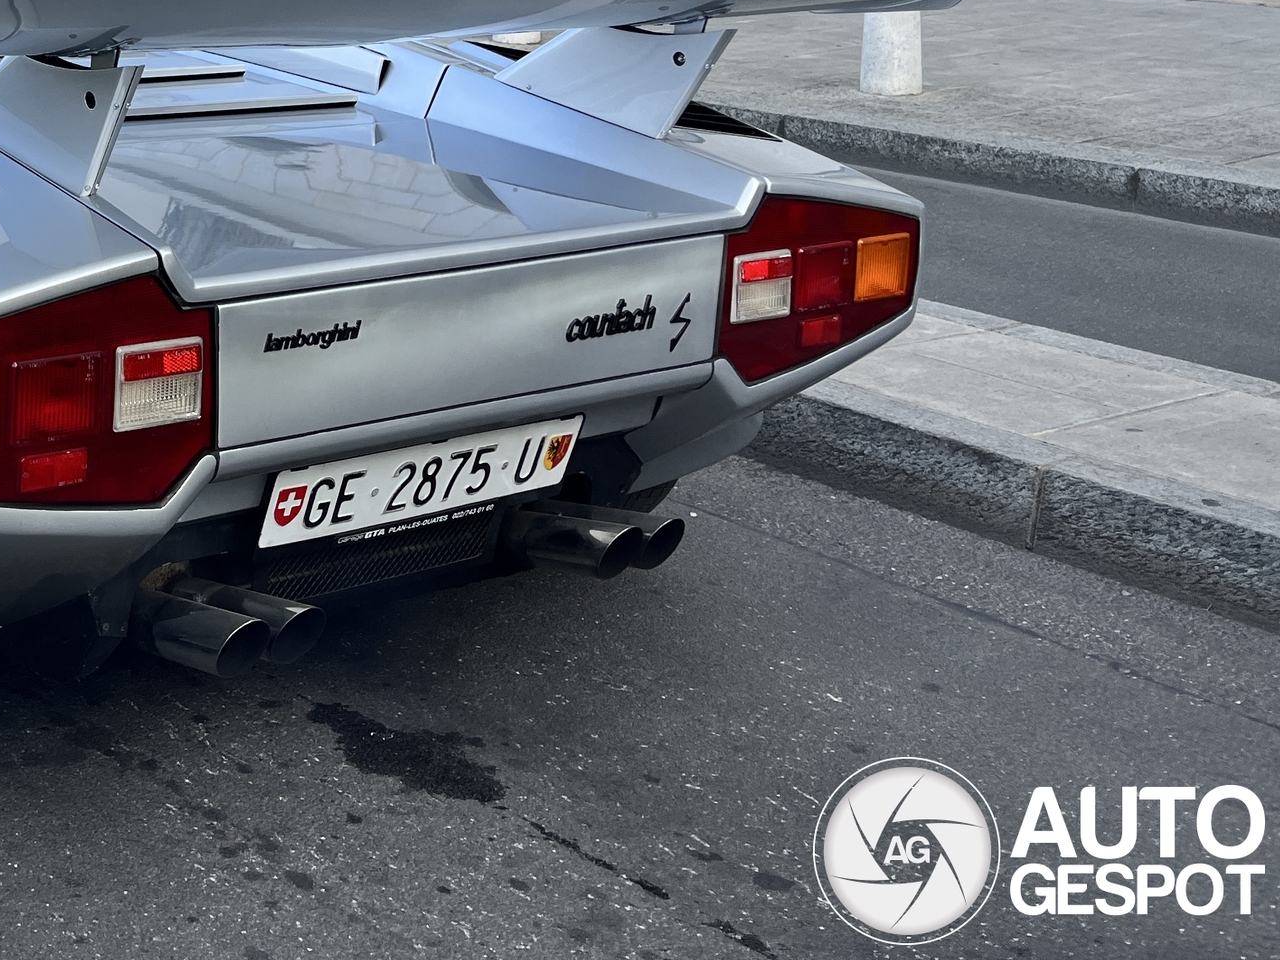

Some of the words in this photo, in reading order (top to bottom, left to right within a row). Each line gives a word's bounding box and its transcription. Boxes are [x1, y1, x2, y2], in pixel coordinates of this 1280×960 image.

[263, 320, 363, 353] lamborghini
[565, 294, 657, 344] countach
[302, 469, 368, 530] GE
[381, 443, 499, 516] 2875
[513, 435, 548, 486] U
[364, 528, 386, 539] GTA
